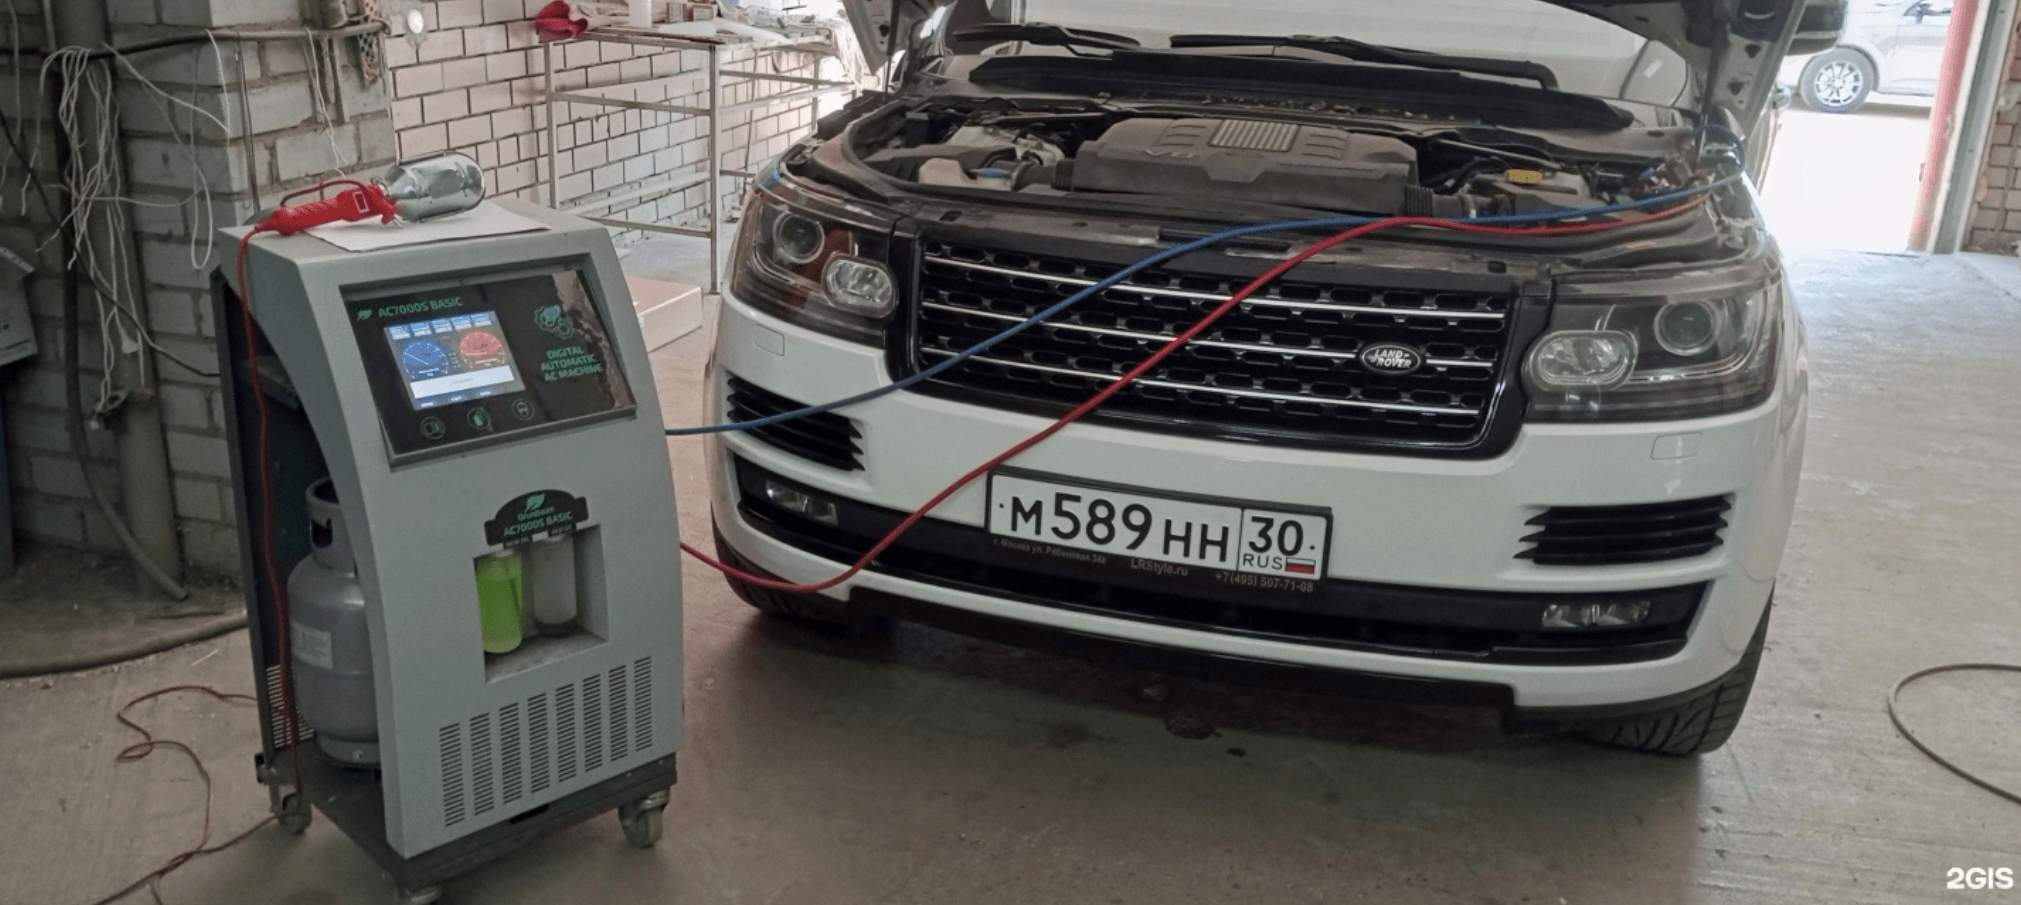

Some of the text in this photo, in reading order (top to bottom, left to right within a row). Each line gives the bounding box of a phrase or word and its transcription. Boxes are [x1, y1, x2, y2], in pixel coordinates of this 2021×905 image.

[379, 296, 463, 317] AC7000S BASIC
[541, 353, 597, 371] AUTOMATIC
[547, 346, 585, 360] DIGITAL
[1376, 357, 1412, 368] ROVER
[545, 363, 604, 381] AC MACHINE
[503, 510, 573, 537] AC7000S BASIC
[1001, 538, 1031, 552] Москва
[1248, 515, 1304, 557] 30
[1130, 557, 1189, 577] LRStyle.ru
[1242, 552, 1283, 570] RUS
[1215, 571, 1314, 594] +7(495) 507-71-08
